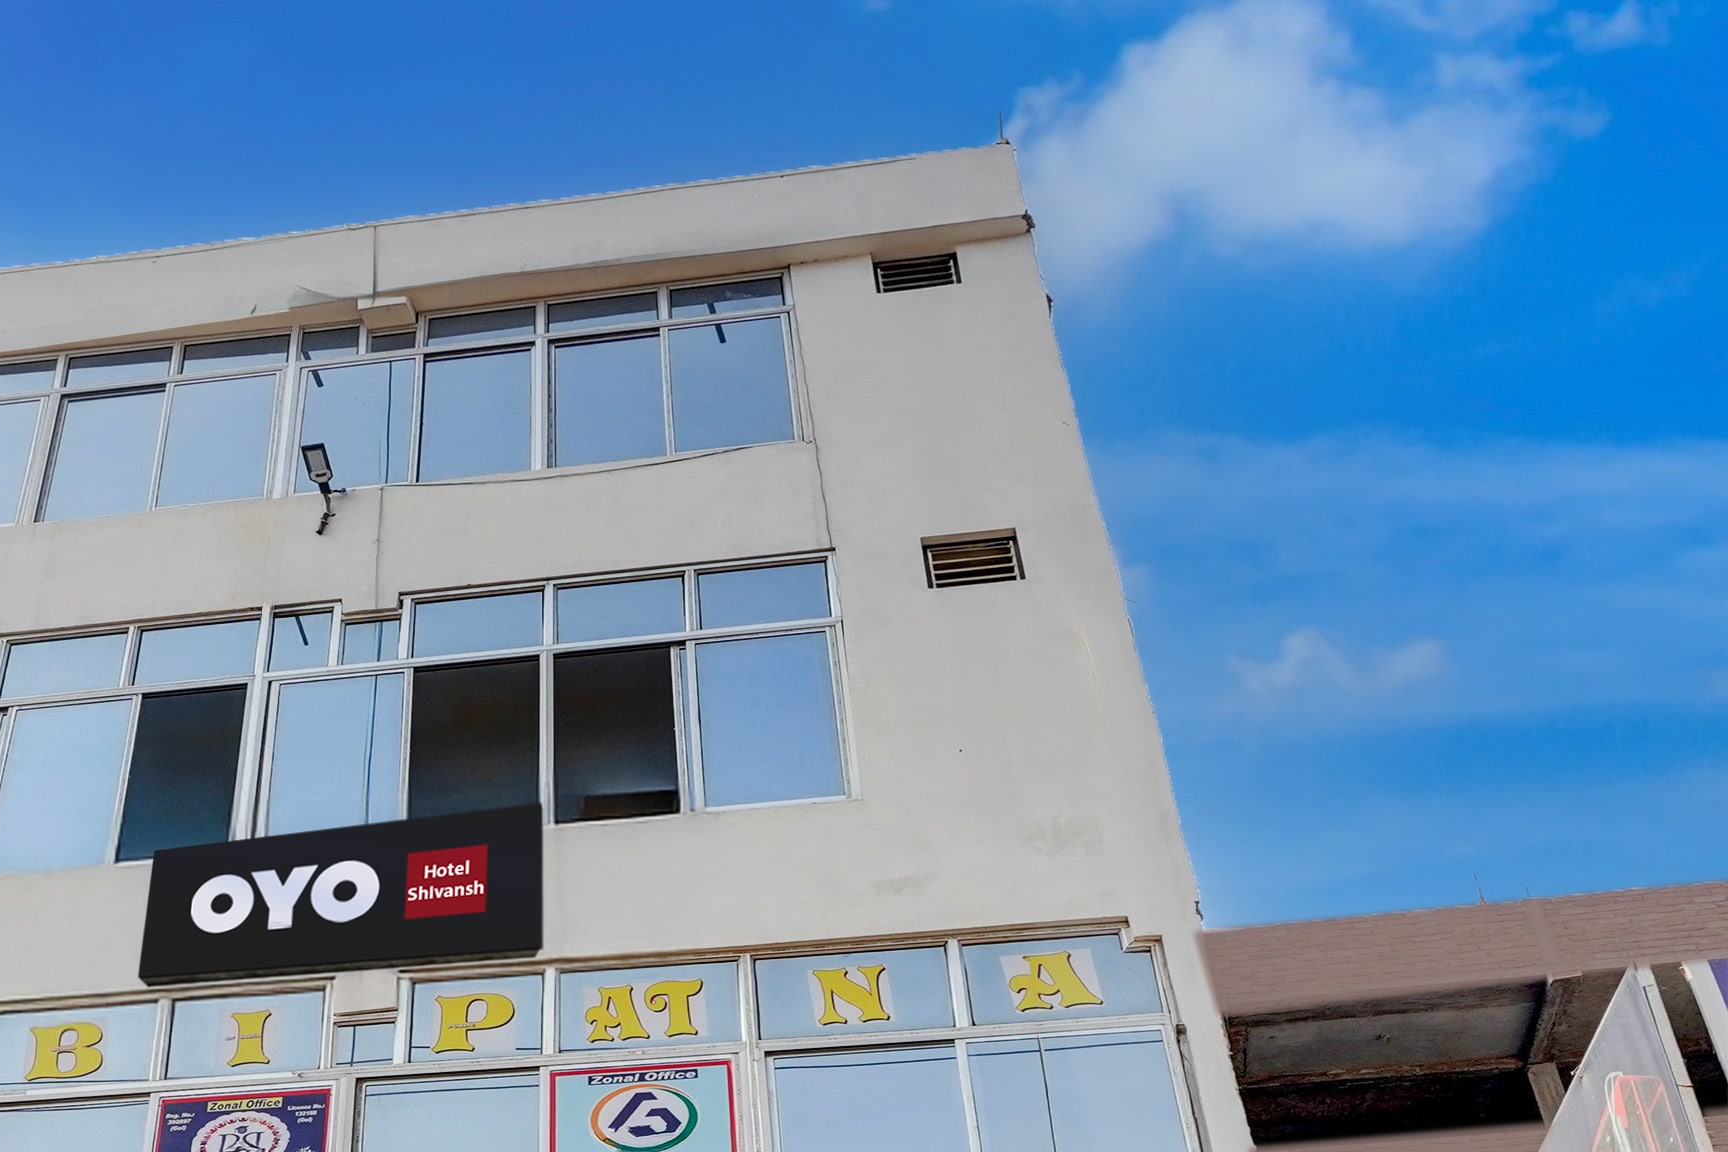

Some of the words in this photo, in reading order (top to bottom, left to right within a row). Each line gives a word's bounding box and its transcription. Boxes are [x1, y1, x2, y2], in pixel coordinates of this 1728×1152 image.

[423, 860, 471, 880] Hotel
[190, 859, 381, 934] OYO
[407, 880, 485, 901] Shivansh
[590, 1074, 639, 1085] Zonal
[644, 1069, 697, 1081] Office
[209, 1101, 243, 1112] Zonal
[246, 1099, 281, 1109] Office
